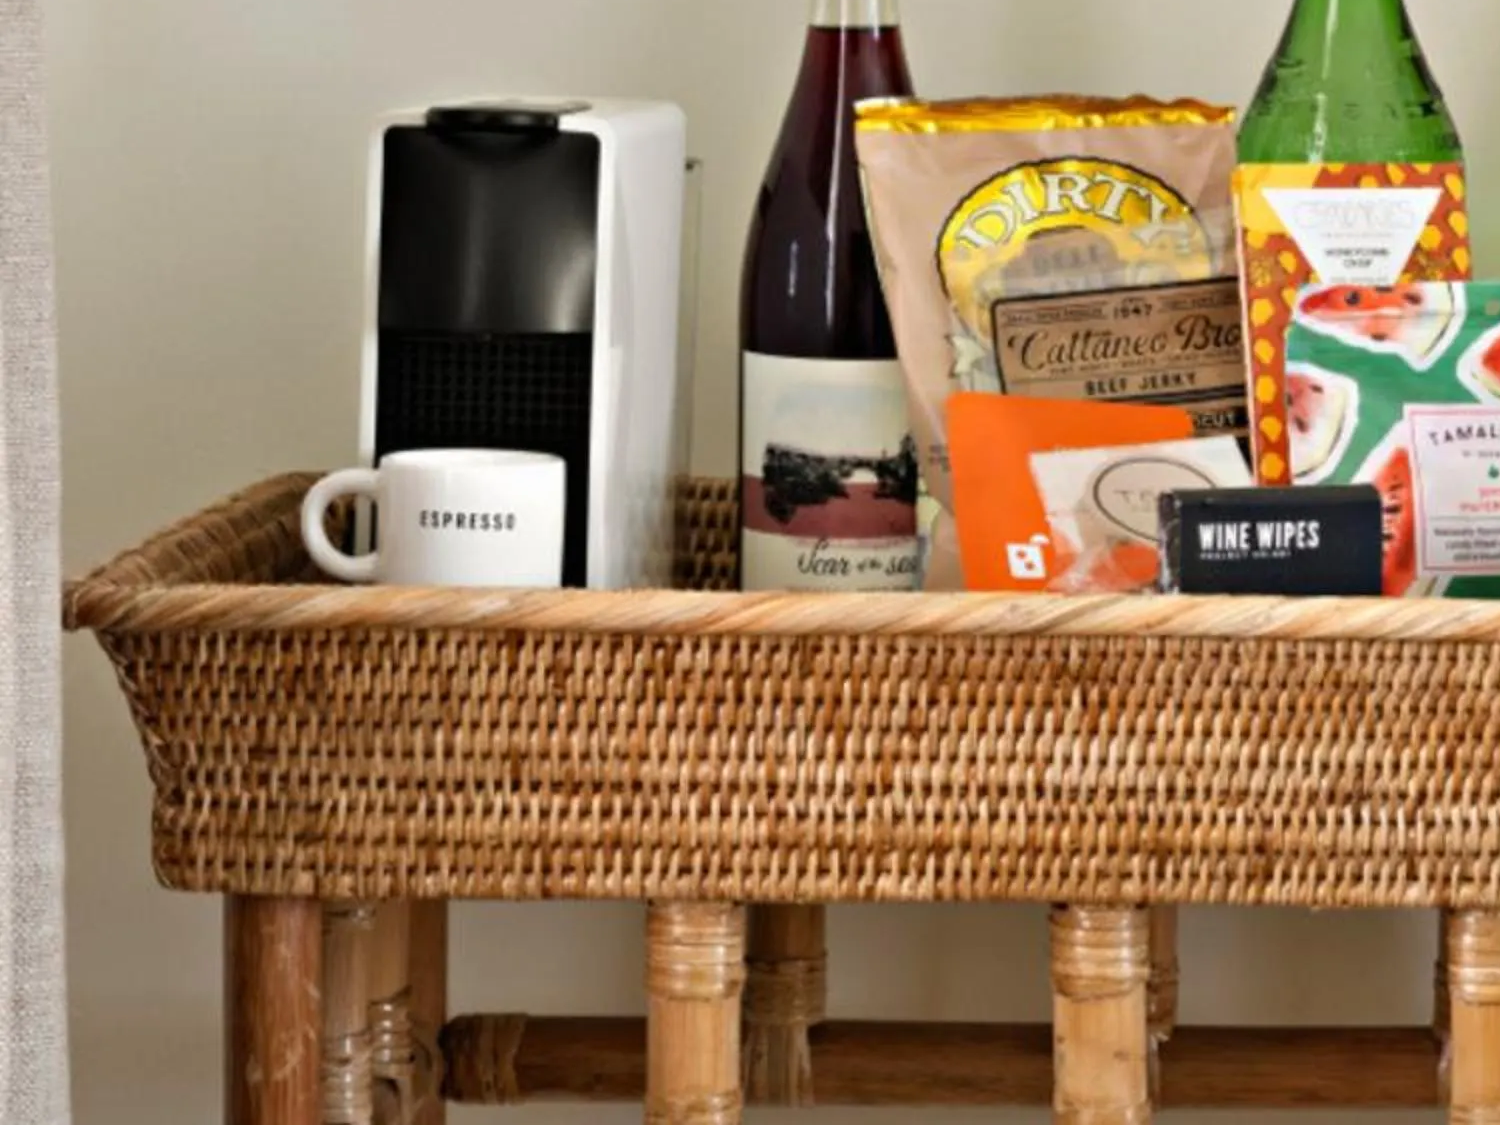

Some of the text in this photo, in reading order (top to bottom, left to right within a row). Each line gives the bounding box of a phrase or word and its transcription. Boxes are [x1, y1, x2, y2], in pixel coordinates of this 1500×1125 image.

[957, 172, 1189, 249] DIRTY
[418, 510, 517, 531] ESPRESSO
[1198, 520, 1320, 551] WINE WIPES
